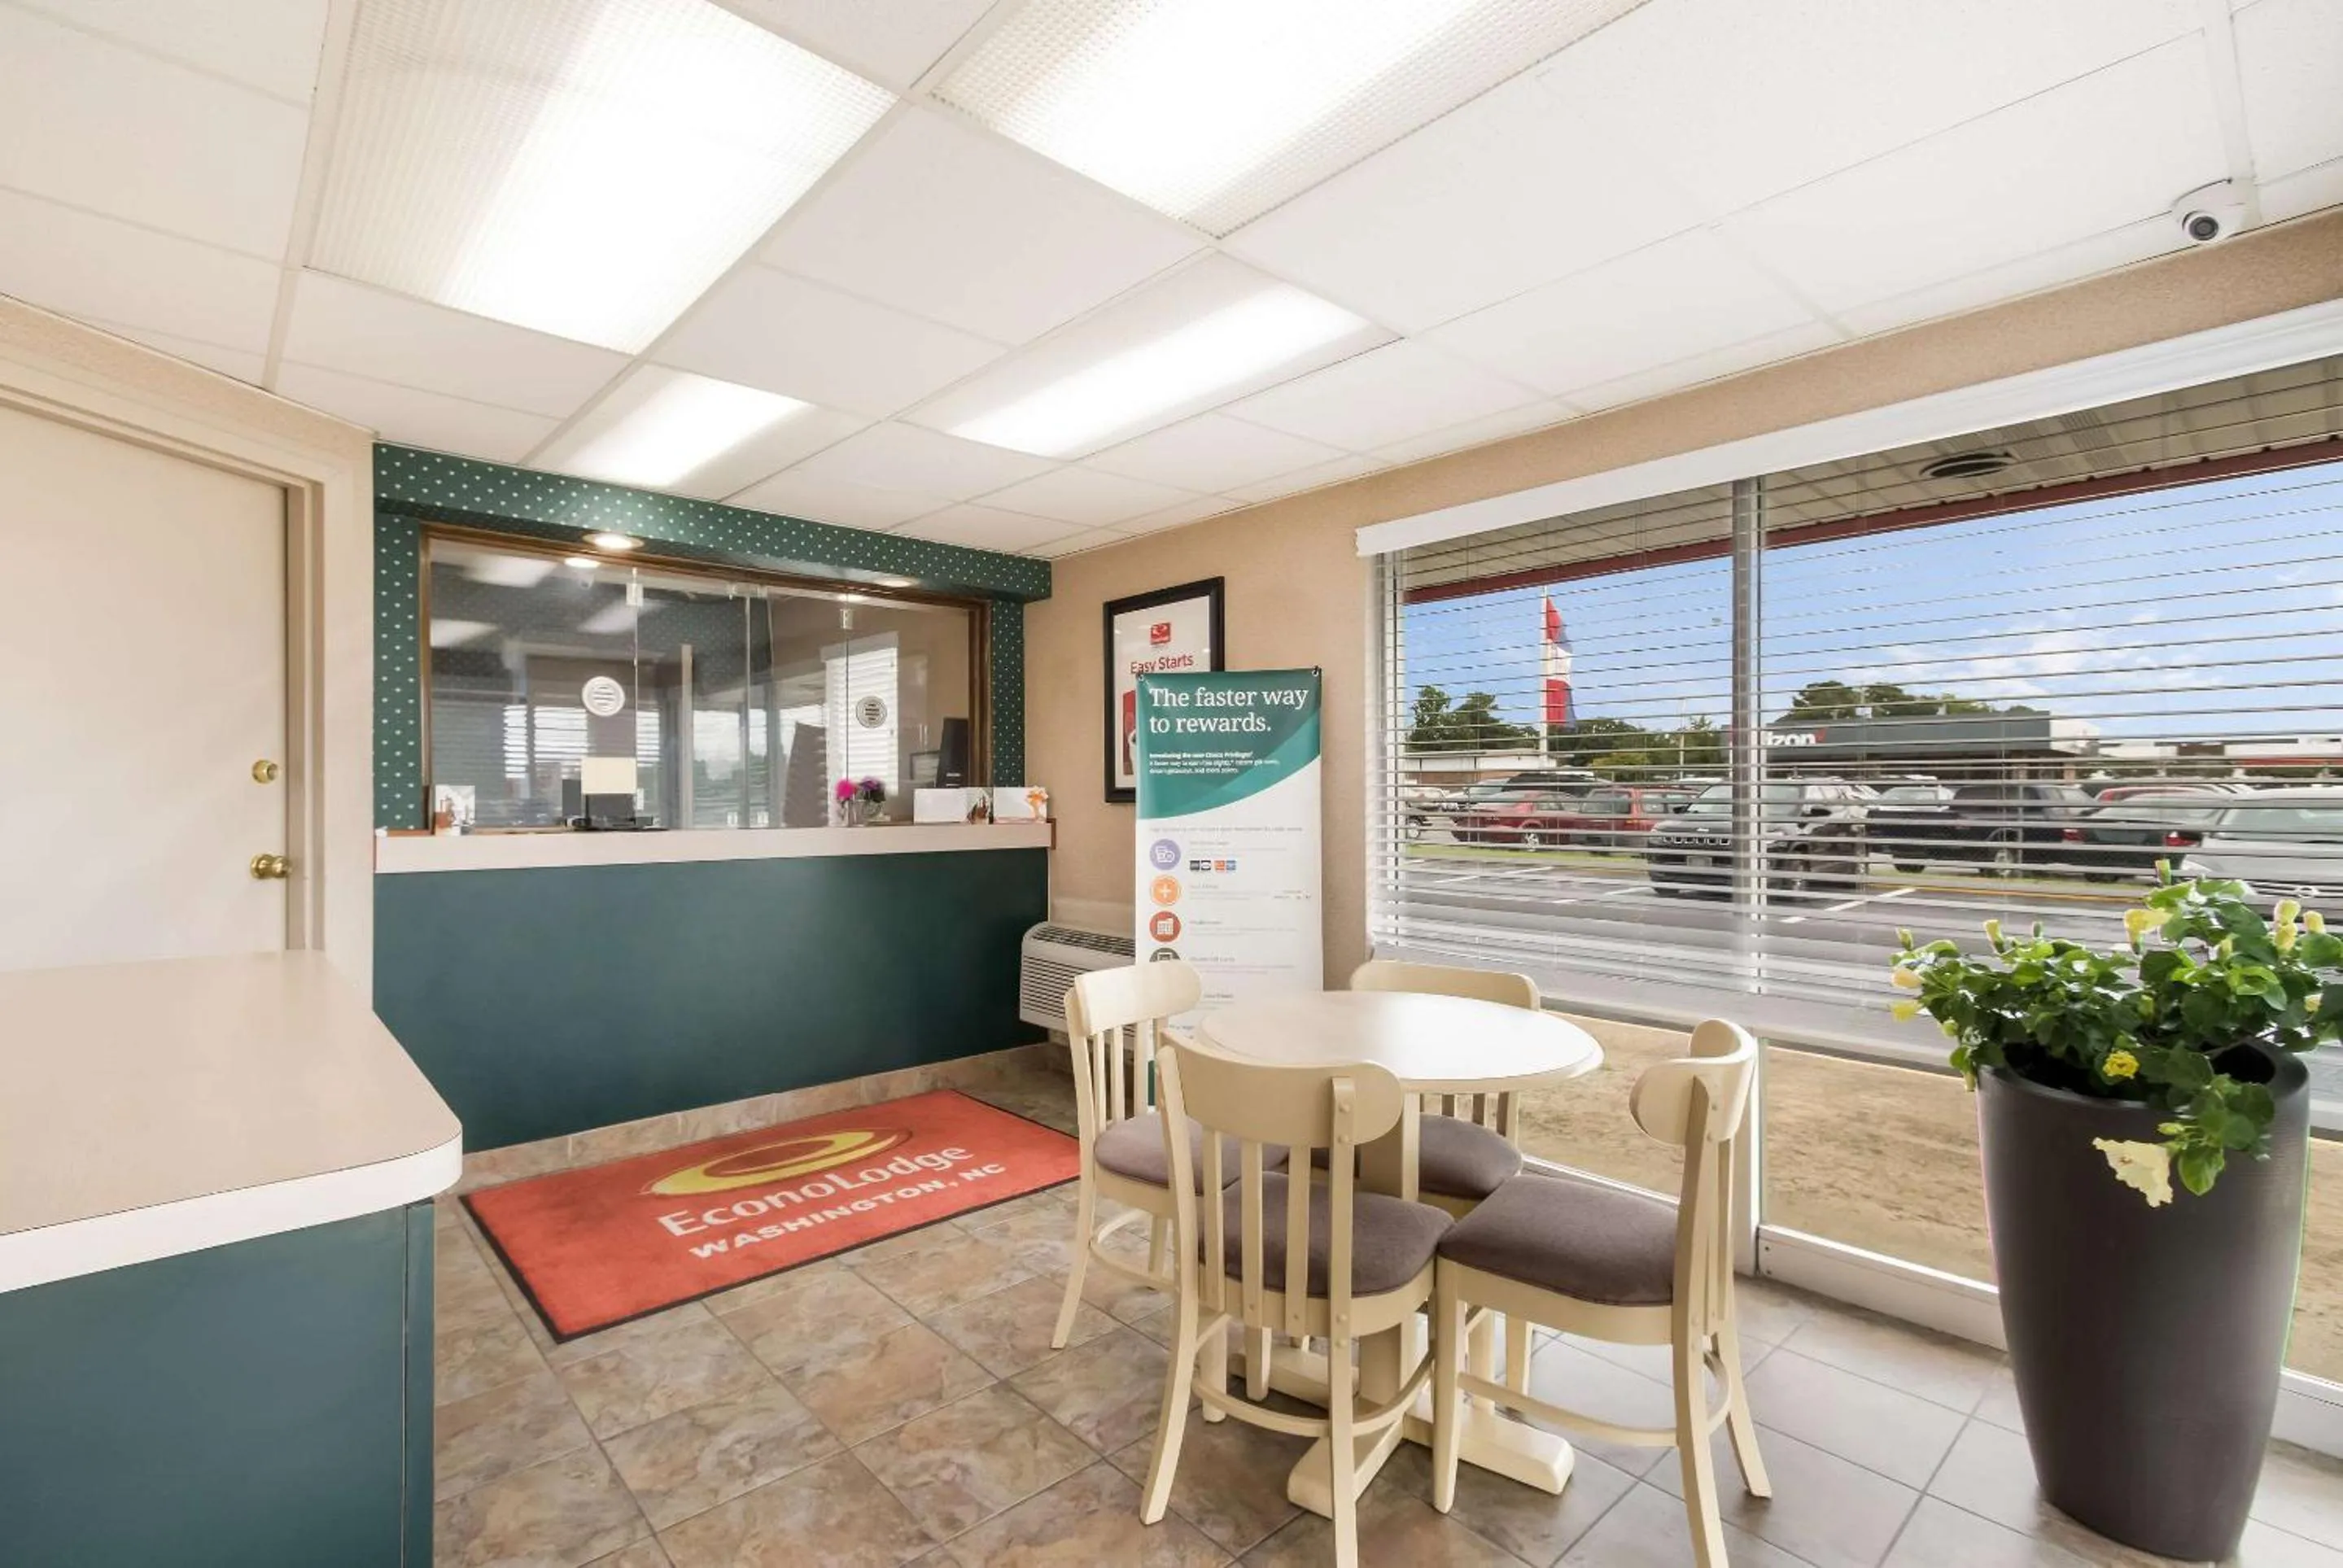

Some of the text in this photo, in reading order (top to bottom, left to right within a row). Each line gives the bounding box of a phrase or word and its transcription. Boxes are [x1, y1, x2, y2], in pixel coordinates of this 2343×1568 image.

[1130, 654, 1195, 675] Easy Starts
[1149, 687, 1309, 710] The faster way
[1149, 712, 1272, 734] to rewards.
[1765, 731, 1816, 746] izon
[658, 1146, 974, 1237] EconoLodge
[689, 1163, 1007, 1259] WASHINGTON, NC
